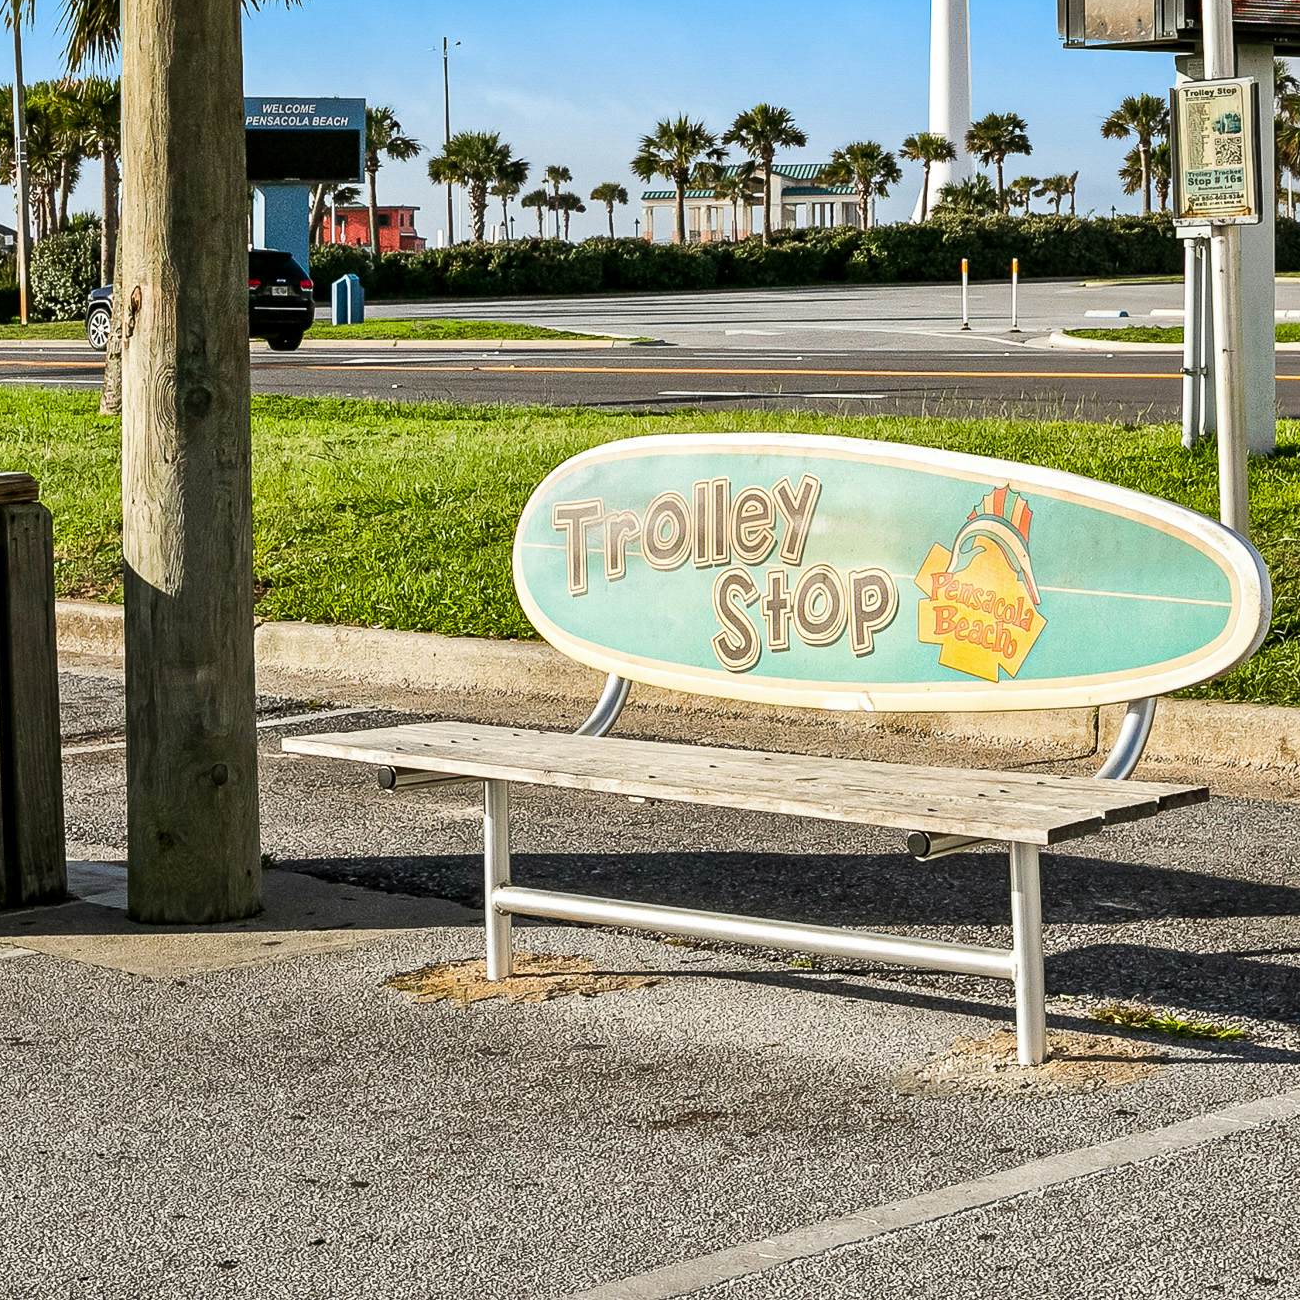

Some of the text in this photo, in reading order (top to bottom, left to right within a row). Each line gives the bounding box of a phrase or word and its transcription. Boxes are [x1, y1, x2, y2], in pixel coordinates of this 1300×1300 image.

[1183, 87, 1237, 97] Trolley Stop
[245, 116, 348, 126] PENSACOLA BEACH
[262, 104, 316, 114] WELCOME
[1188, 177, 1211, 186] Stop
[552, 472, 822, 597] Trolley
[930, 571, 1035, 632] Pensacola
[712, 564, 900, 673] Stop
[932, 604, 1018, 659] Beach
